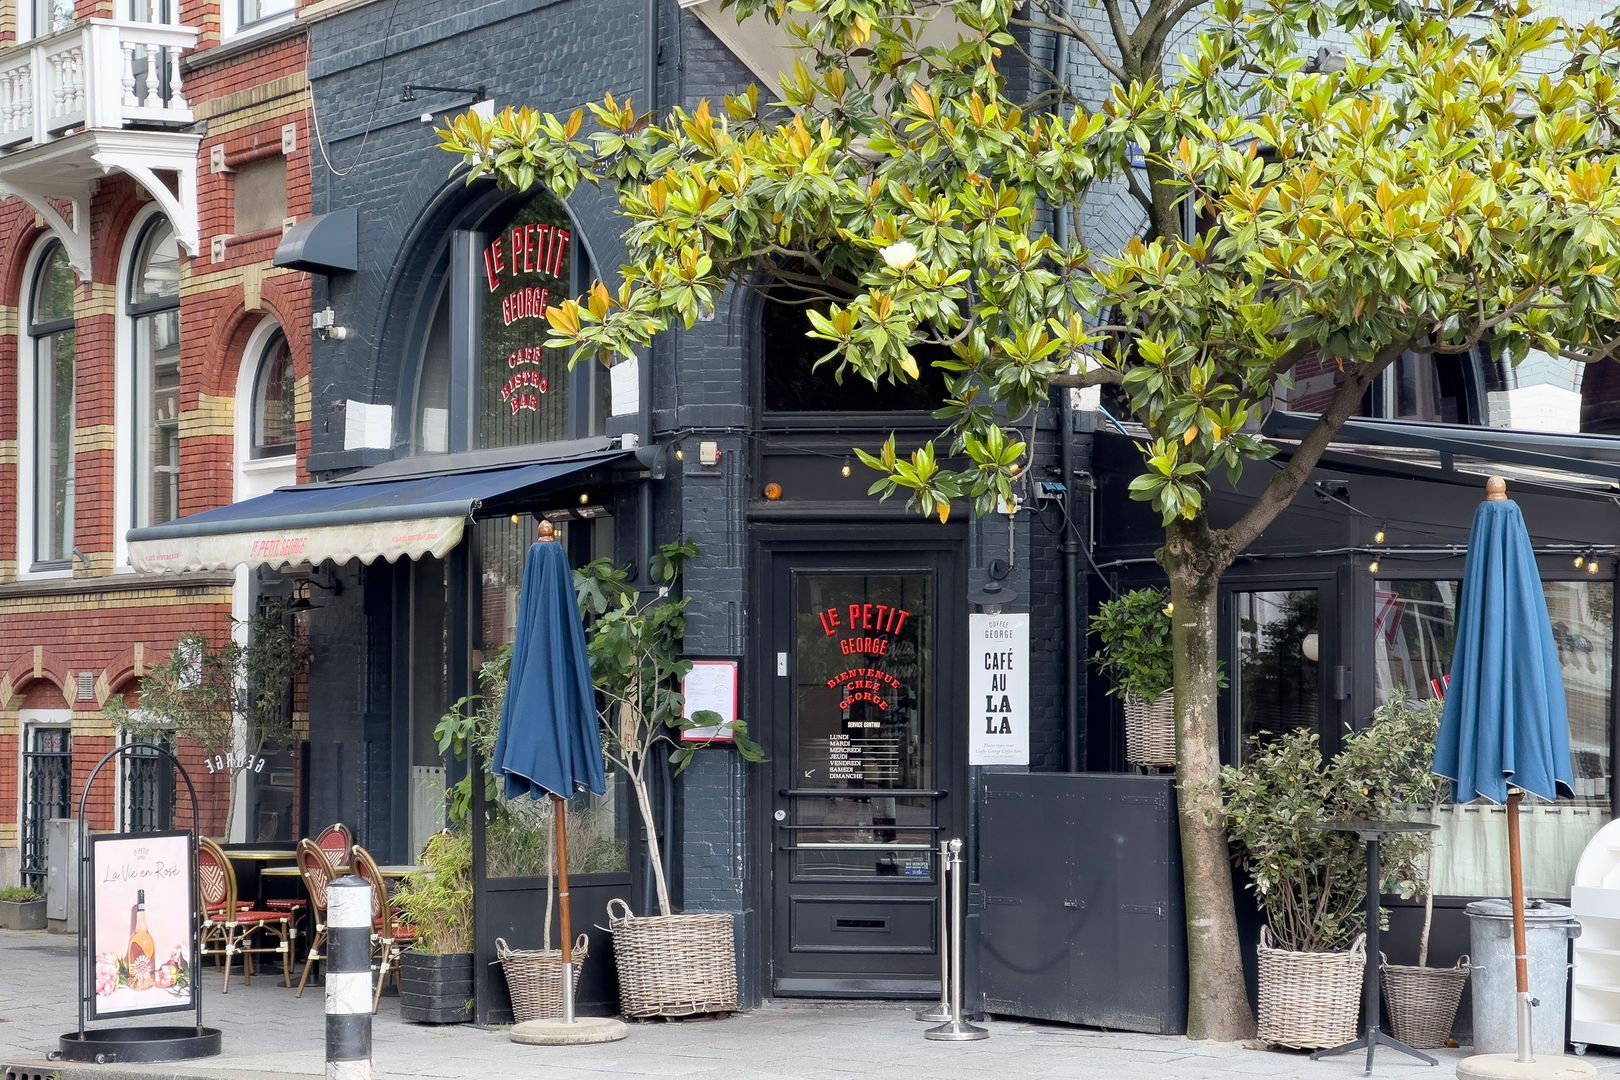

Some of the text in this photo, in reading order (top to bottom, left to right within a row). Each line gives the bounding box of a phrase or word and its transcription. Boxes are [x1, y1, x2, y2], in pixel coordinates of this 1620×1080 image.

[484, 224, 570, 293] LE PETIT
[503, 287, 550, 326] GEORGE
[500, 370, 549, 402] BISTRO
[510, 393, 539, 416] BAR
[819, 603, 911, 637] LE PETIT
[984, 629, 1013, 639] GEORGE
[841, 637, 888, 656] GEORGE
[984, 648, 1014, 670] CAFÉ
[827, 668, 901, 689] BIENVENUE
[847, 680, 881, 692] CHEZ
[991, 673, 1007, 692] AU
[839, 692, 889, 710] GEORGE
[985, 695, 1012, 713] LA
[985, 716, 1012, 734] LA
[103, 861, 180, 883] La Vie en Rosé
